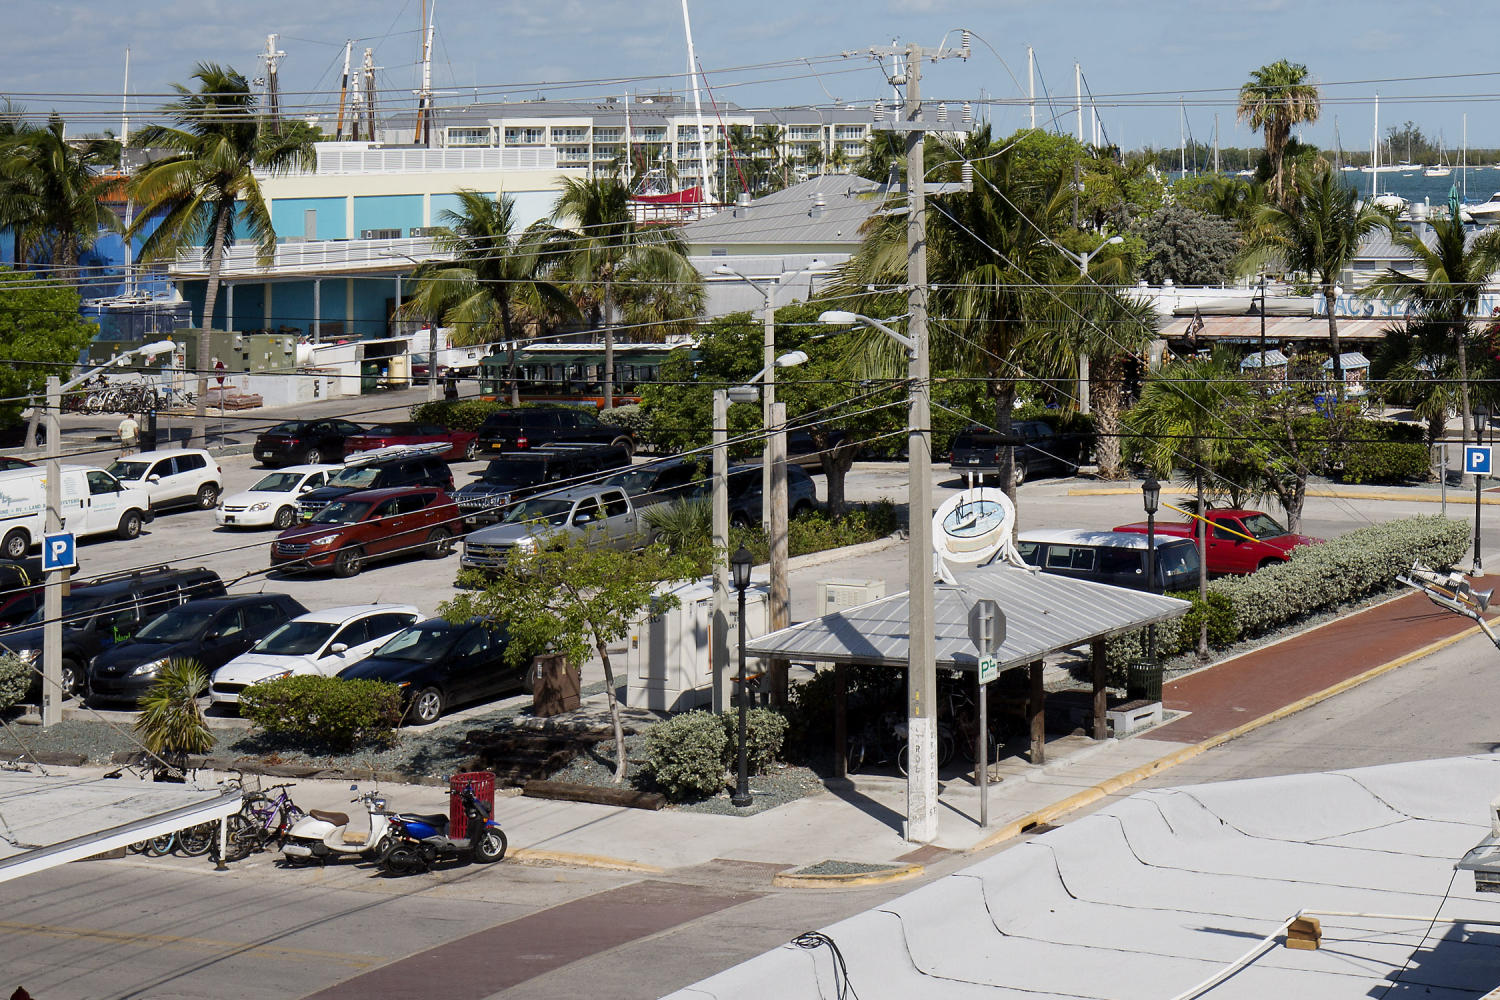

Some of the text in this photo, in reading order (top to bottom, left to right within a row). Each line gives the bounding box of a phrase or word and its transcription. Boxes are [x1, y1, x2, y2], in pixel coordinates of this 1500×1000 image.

[1472, 452, 1485, 468] P
[52, 540, 67, 561] P
[981, 661, 990, 679] P
